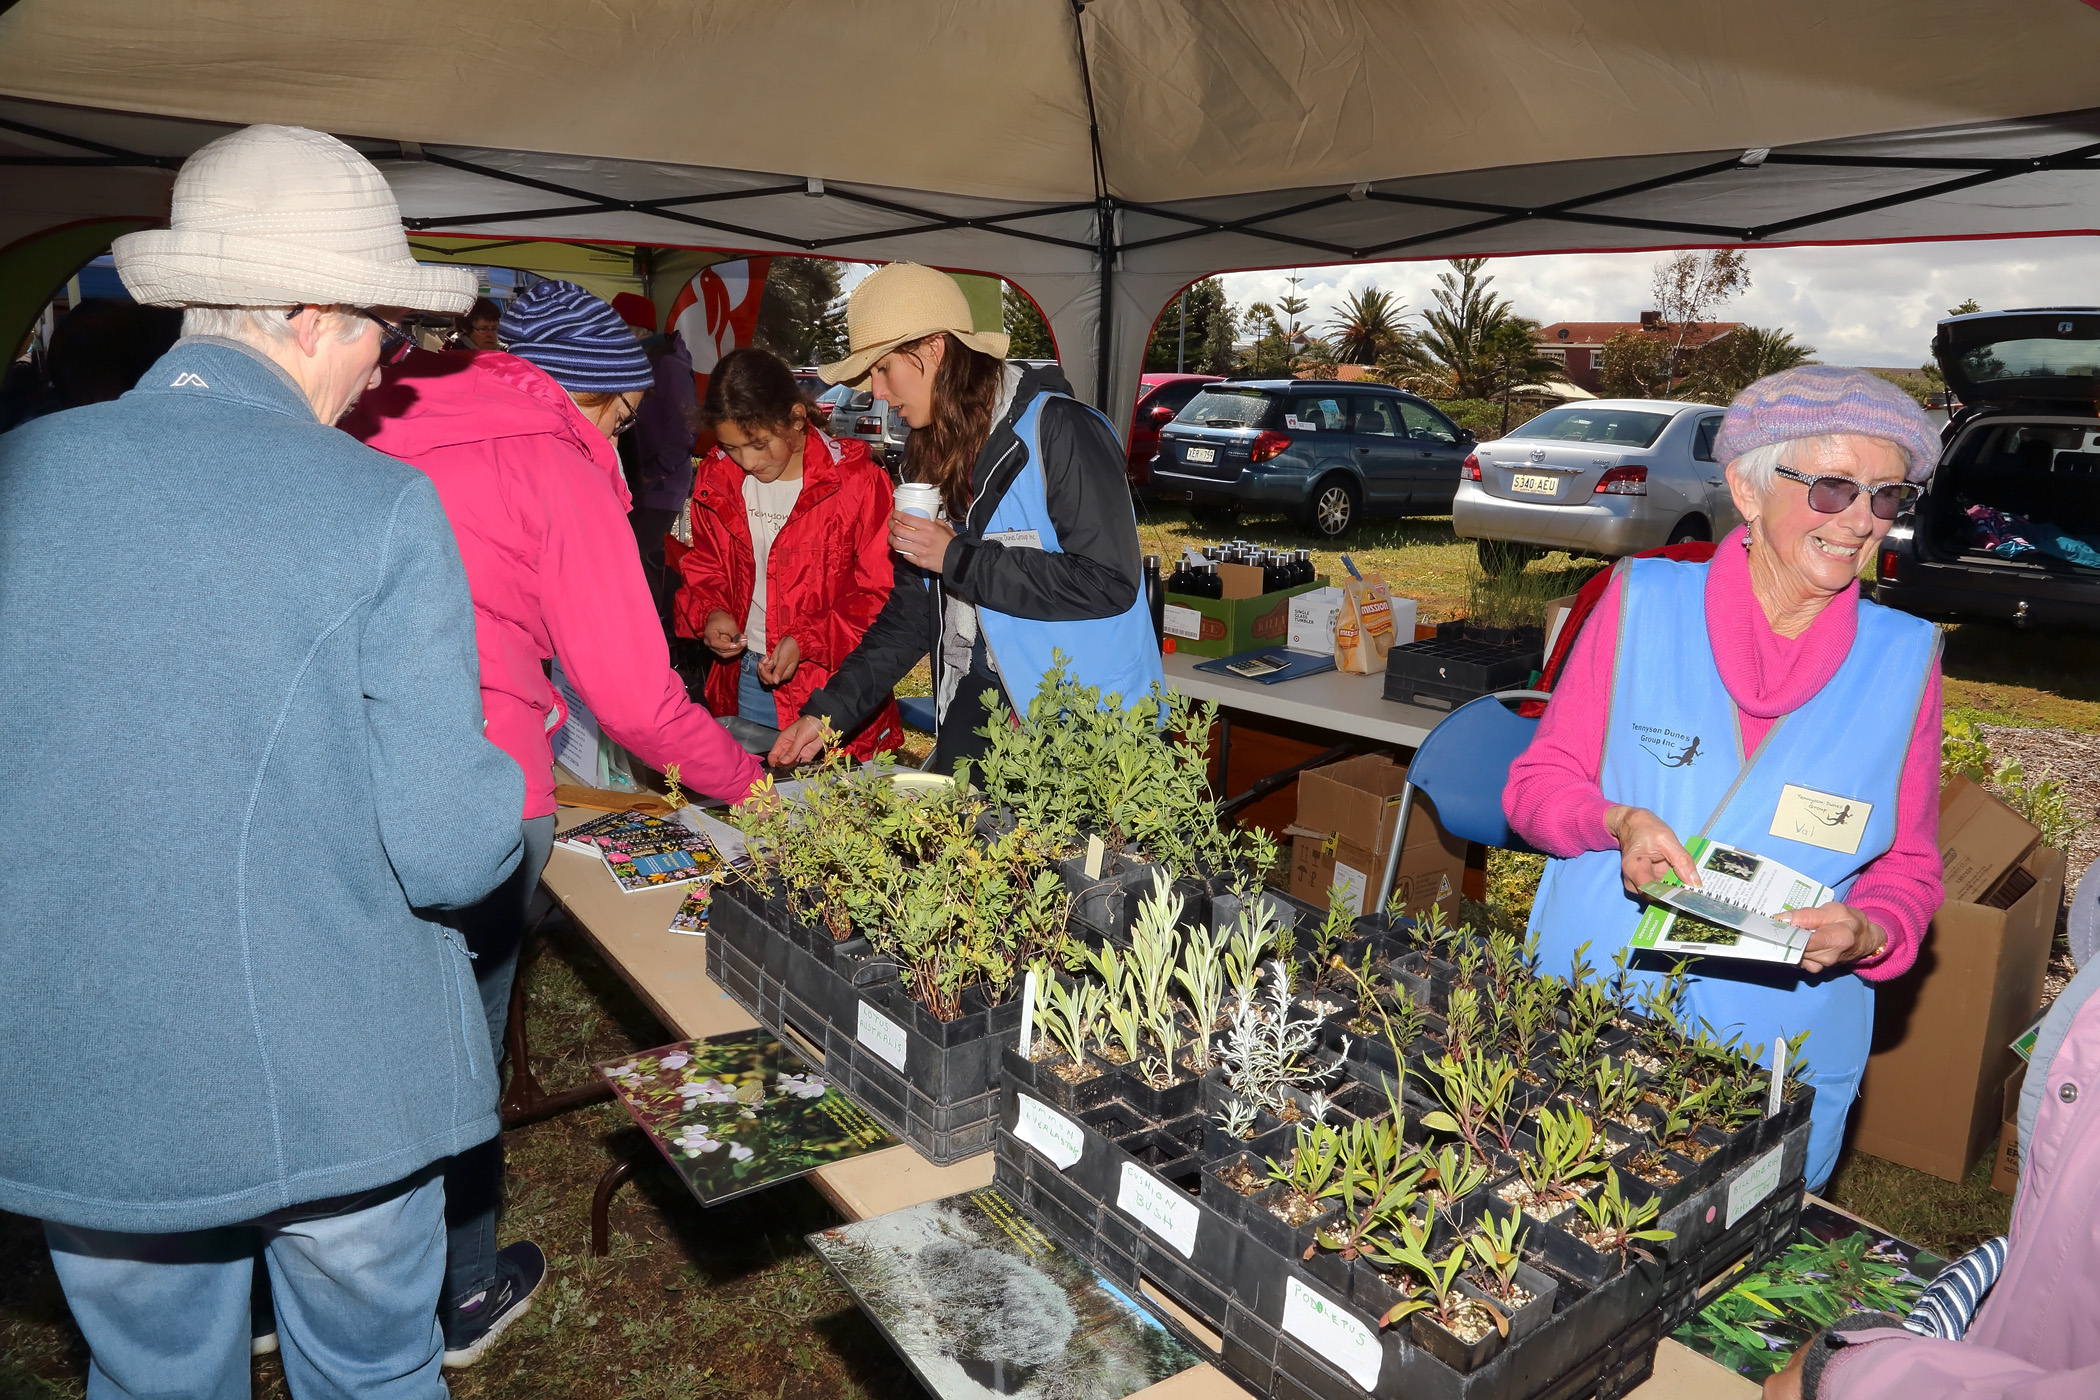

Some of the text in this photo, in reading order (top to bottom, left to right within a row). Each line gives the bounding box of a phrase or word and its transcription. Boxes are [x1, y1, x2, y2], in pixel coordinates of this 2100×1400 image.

[1294, 608, 1310, 616] SINGLE
[1632, 722, 1690, 742] Tennyson Dunes
[1640, 734, 1676, 748] Group Inc
[1795, 820, 1815, 838] Val
[863, 1006, 889, 1032] LOTUS
[859, 1019, 903, 1052] AUSTRALIS
[1127, 1167, 1177, 1210] CUSHION
[1135, 1189, 1174, 1230] BUSH
